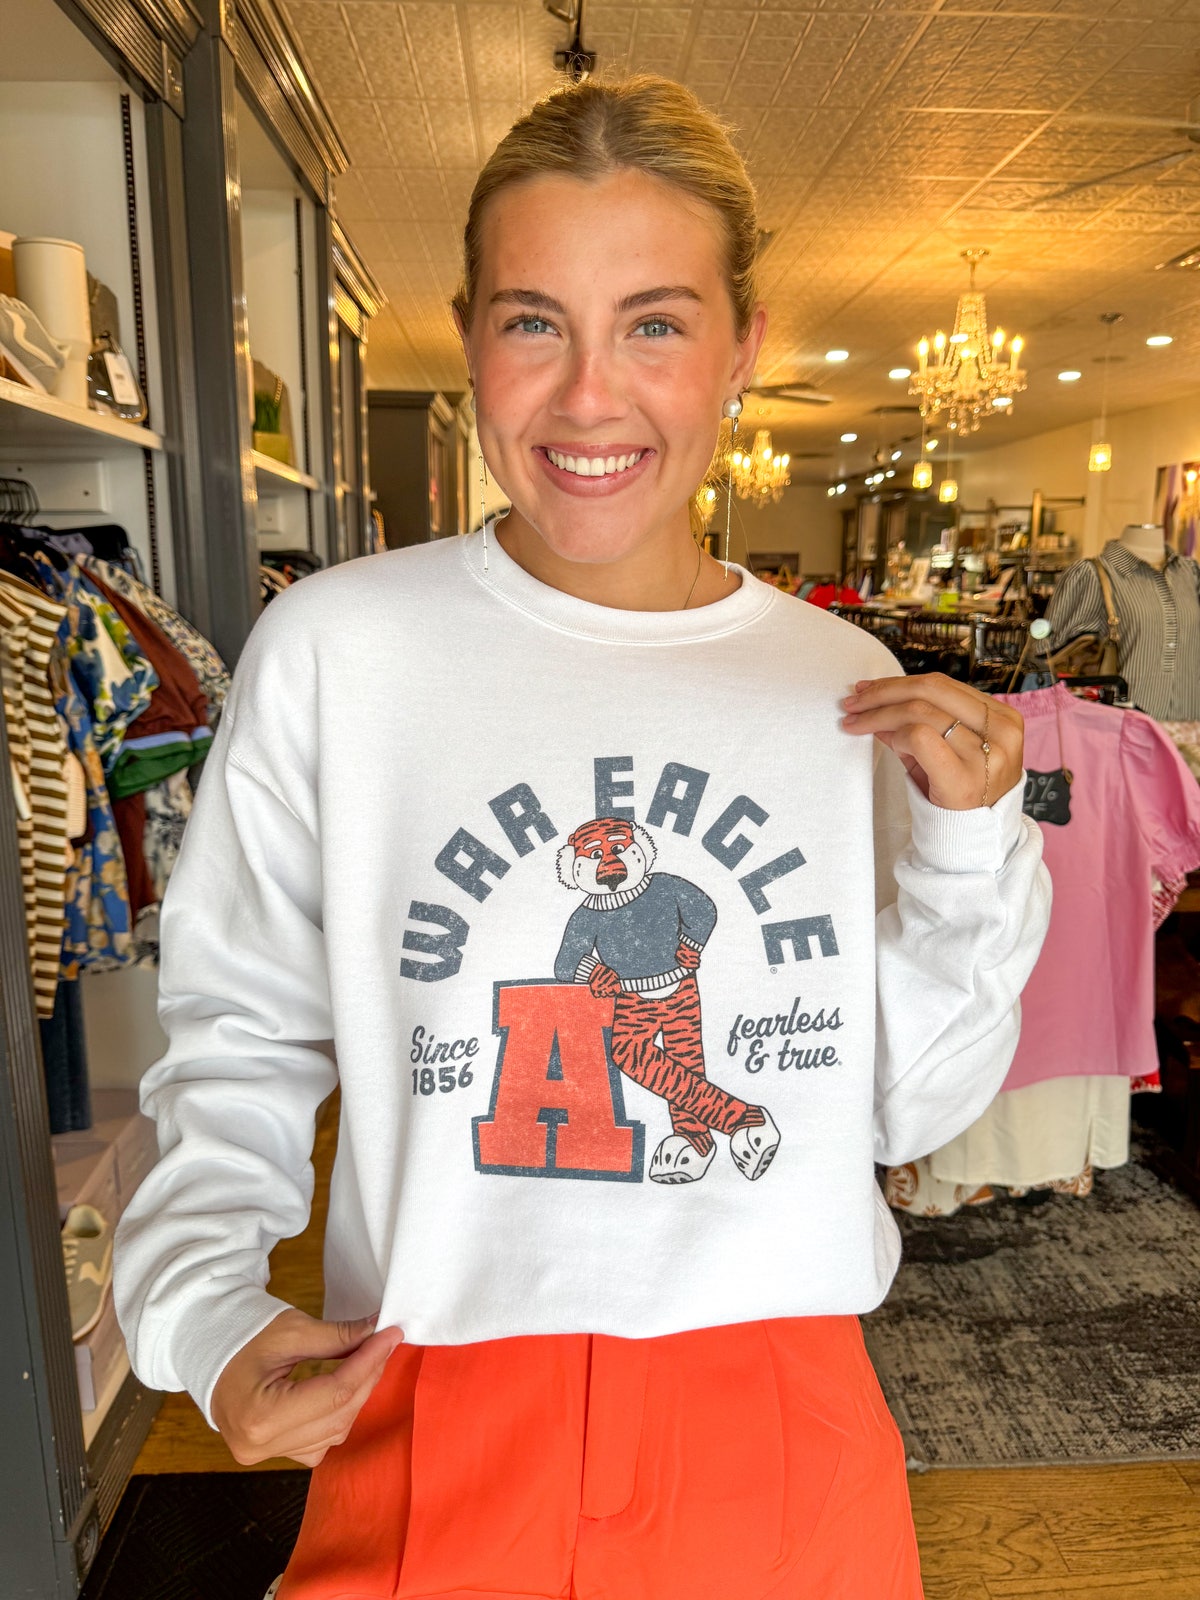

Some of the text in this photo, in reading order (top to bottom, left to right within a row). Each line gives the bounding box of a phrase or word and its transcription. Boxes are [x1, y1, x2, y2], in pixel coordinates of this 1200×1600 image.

[1024, 776, 1058, 801] 0%
[400, 756, 840, 983] WAR EAGLE
[410, 1025, 480, 1064] Since
[727, 996, 844, 1057] fearless
[744, 1038, 770, 1074] &
[411, 1061, 474, 1096] 1856
[471, 978, 646, 1183] A
